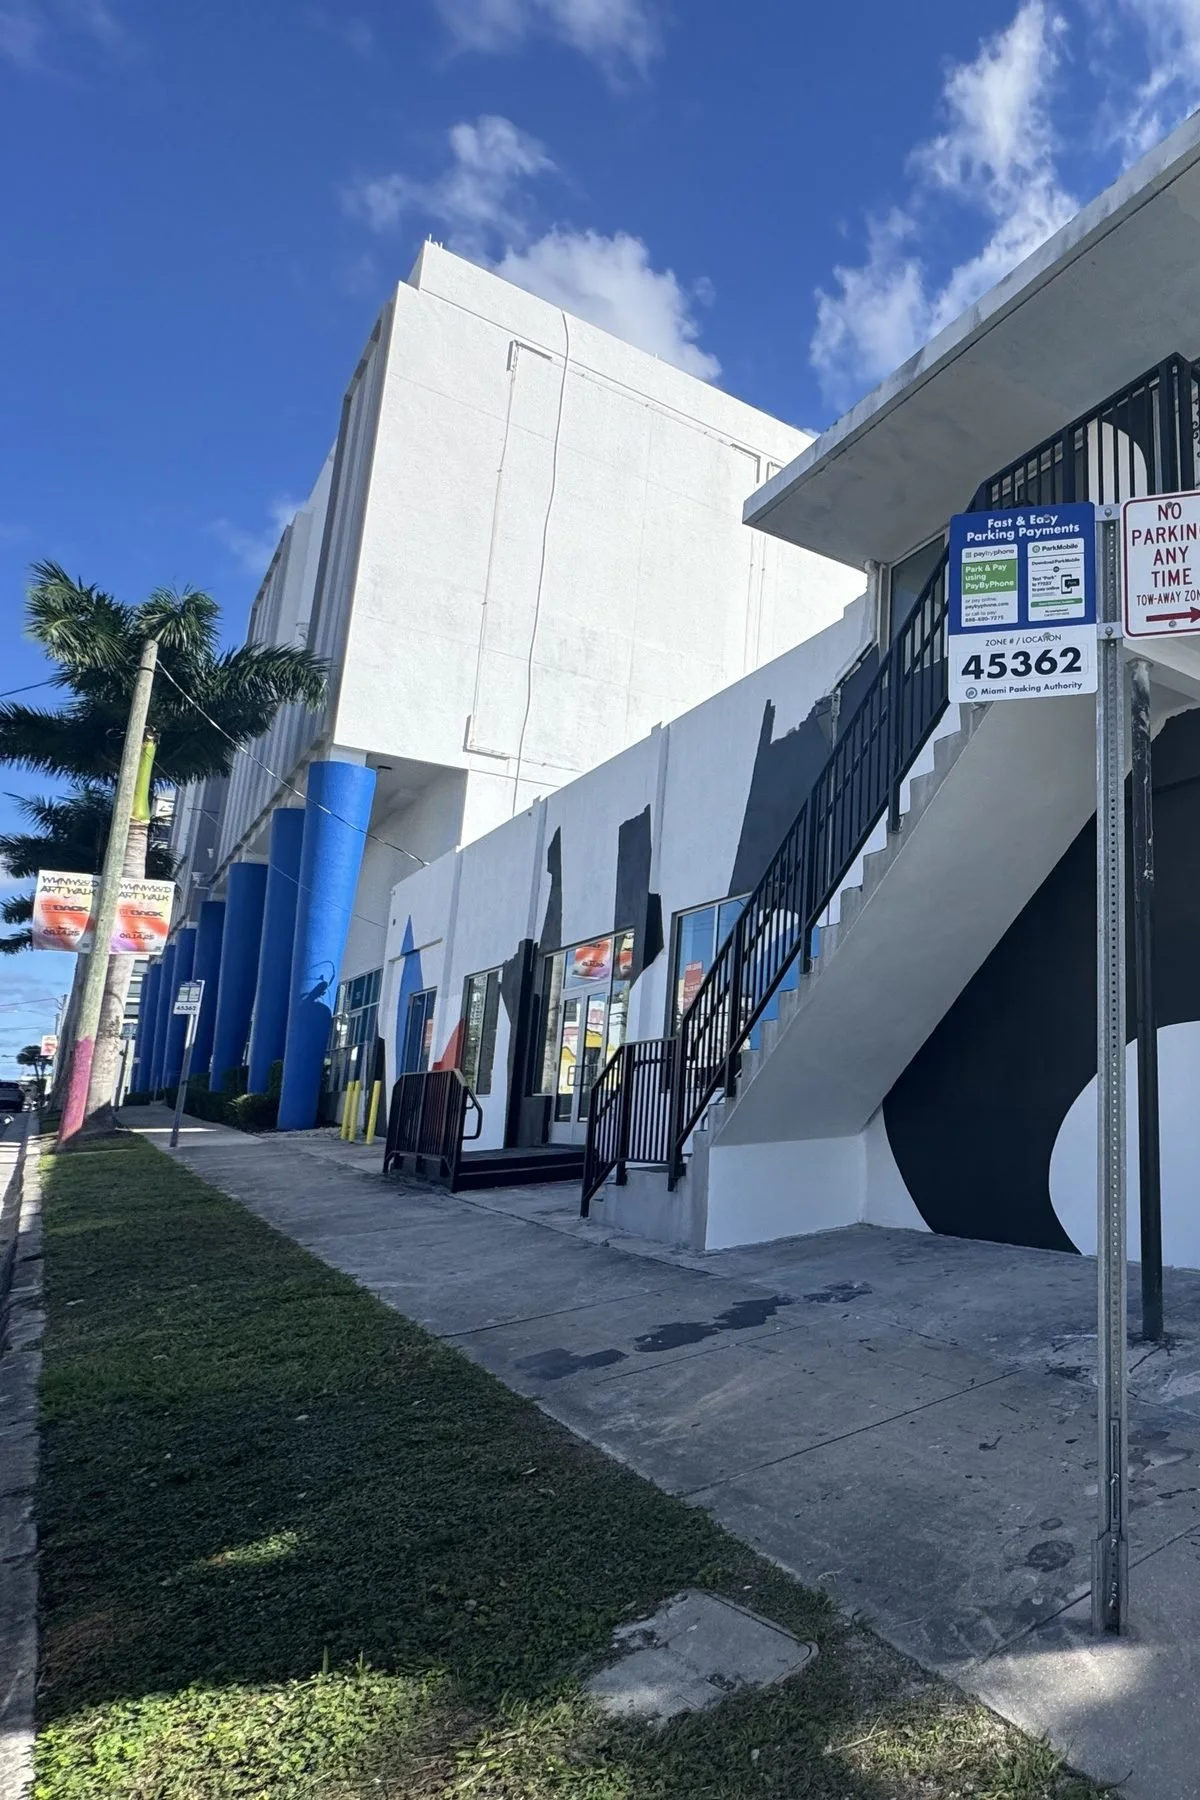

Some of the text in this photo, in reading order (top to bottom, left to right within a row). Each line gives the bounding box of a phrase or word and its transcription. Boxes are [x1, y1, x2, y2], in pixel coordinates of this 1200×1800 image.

[1158, 502, 1182, 521] NO
[987, 518, 1013, 529] Fast
[1015, 516, 1026, 526] &
[966, 523, 1080, 542] Parking Payments
[1041, 543, 1079, 552] ParkMobile
[1153, 545, 1189, 566] ANY
[984, 564, 991, 572] &
[992, 563, 1008, 572] Pay
[965, 573, 987, 581] using
[1151, 567, 1193, 588] TIME
[965, 580, 1015, 590] PayByPhone
[1136, 591, 1181, 606] TOW-AWAY
[985, 638, 1007, 647] ZONE
[961, 646, 1082, 680] 45362
[980, 681, 1082, 696] Miami Parking Authority
[40, 886, 97, 896] ART WALK
[119, 891, 170, 901] ART WALK
